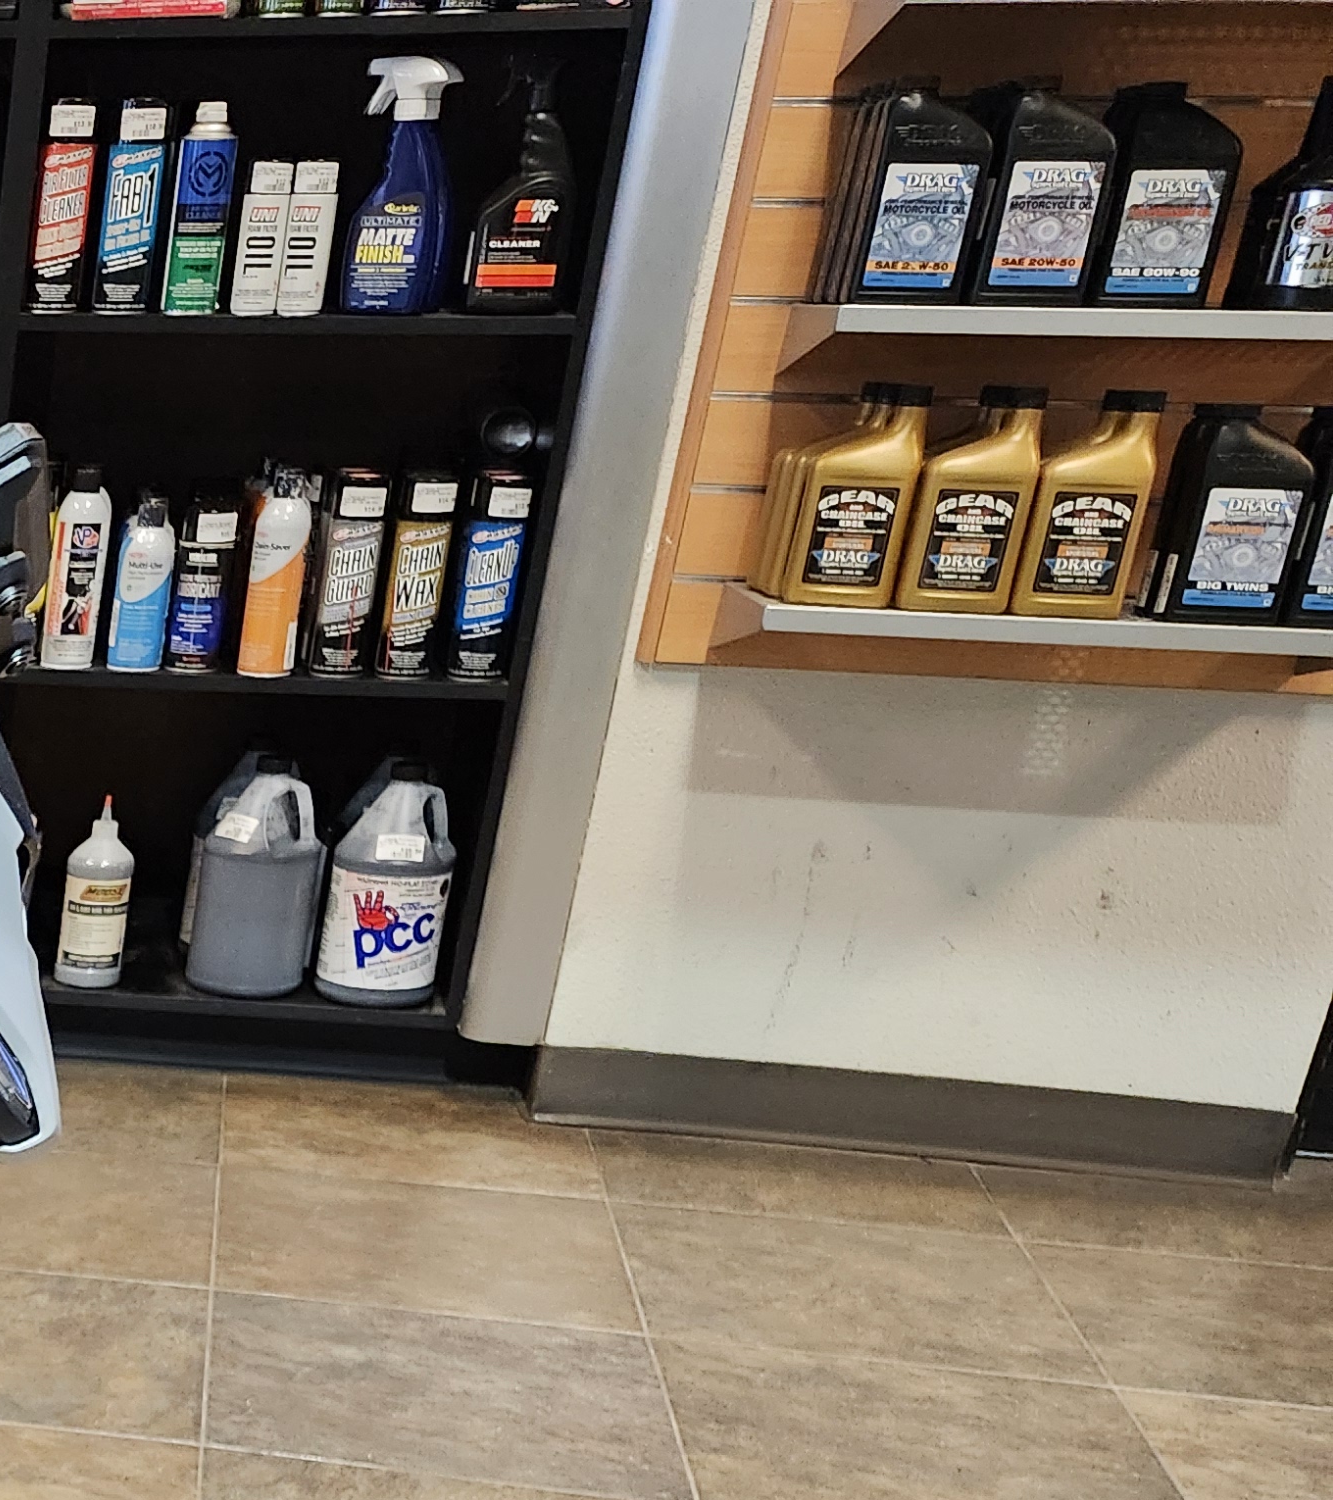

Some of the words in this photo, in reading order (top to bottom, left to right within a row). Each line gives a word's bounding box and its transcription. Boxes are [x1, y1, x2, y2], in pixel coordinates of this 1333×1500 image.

[905, 173, 959, 188] DRAG
[1033, 168, 1086, 183] DRAG
[1147, 178, 1201, 193] DRAG
[39, 190, 86, 226] CLEANER
[884, 204, 949, 215] MOTORCYCLE
[951, 205, 967, 215] OIL
[1009, 200, 1076, 211] MOTORCYCLE
[1078, 201, 1094, 210] OIL
[249, 207, 280, 223] UNI
[291, 206, 322, 223] UNI
[360, 216, 422, 227] ULTIMATE
[358, 228, 416, 246] MATTE
[488, 240, 541, 248] CLEANER
[243, 236, 276, 276] OIL
[284, 236, 317, 277] OIL
[355, 244, 404, 264] FINISH
[875, 261, 898, 270] SAE
[901, 262, 949, 271] 2W-50
[1001, 257, 1025, 266] SAE
[1028, 258, 1076, 267] 20W-50
[1112, 267, 1141, 277] SAE
[818, 490, 895, 515] GEAR
[935, 493, 1014, 520] GEAR
[1052, 496, 1132, 522] GEAR
[1227, 497, 1281, 513] DRAG
[820, 510, 888, 521] CHAINCASE
[938, 514, 1007, 526] CHAINCASE
[1054, 517, 1124, 529] CHAINCASE
[838, 520, 867, 528] OIL
[956, 524, 985, 533] OIL
[1073, 527, 1102, 536] OIL
[329, 543, 378, 577] CHAIN
[397, 539, 446, 576] CHAIN
[822, 550, 869, 564] DRAG
[939, 555, 986, 569] DRAG
[128, 561, 164, 569] Multi-Use
[1055, 558, 1103, 573] DRAG
[325, 572, 374, 606] GUARD
[394, 570, 442, 613] WAX
[1196, 581, 1222, 591] BIG
[1226, 582, 1269, 592] TWINS
[353, 912, 435, 969] pcc
